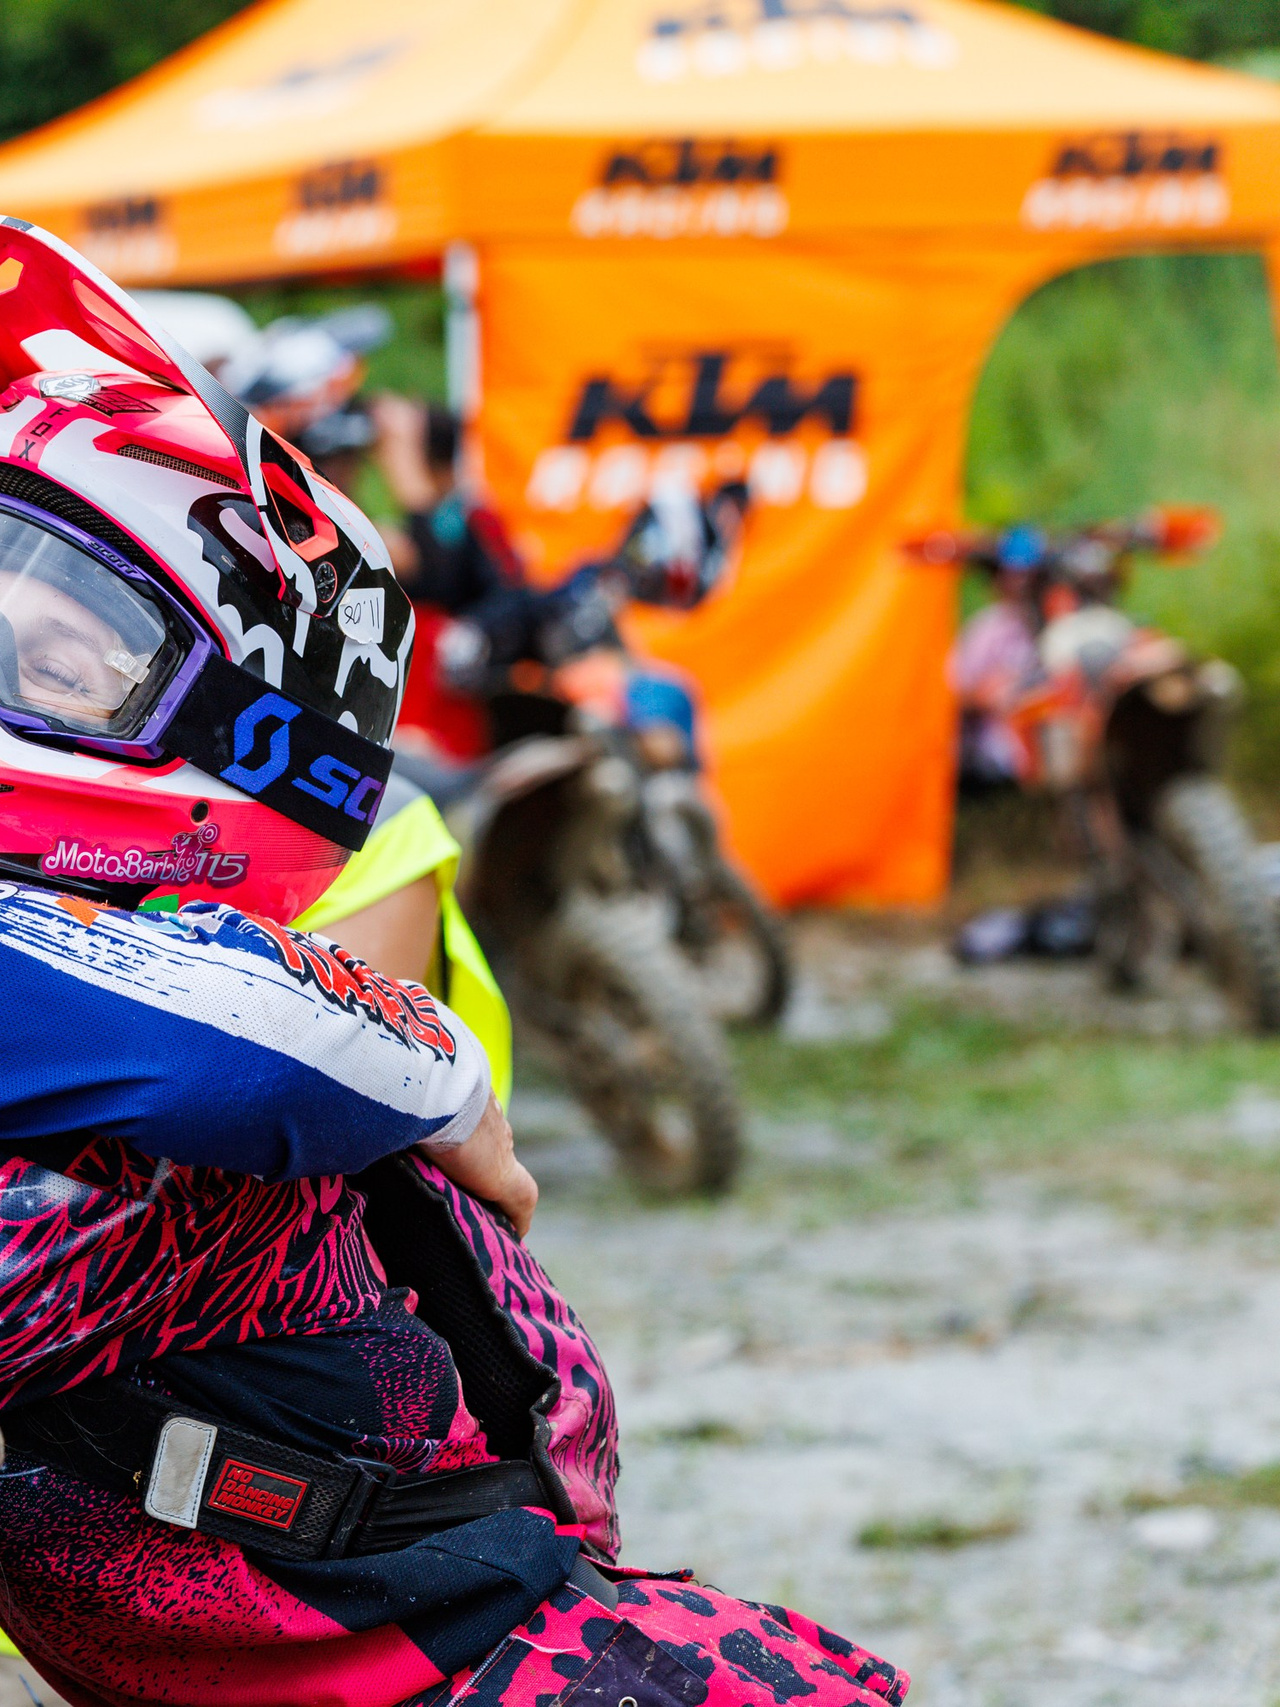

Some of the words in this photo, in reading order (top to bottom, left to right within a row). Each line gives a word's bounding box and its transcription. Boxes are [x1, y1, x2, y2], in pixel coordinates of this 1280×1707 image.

[569, 341, 860, 441] KTM
[88, 540, 138, 574] SCOTT
[291, 754, 387, 825] SC
[194, 852, 246, 881] 115
[227, 1467, 254, 1484] NO
[216, 1491, 289, 1520] MONKEY
[222, 1479, 295, 1510] DANCING
